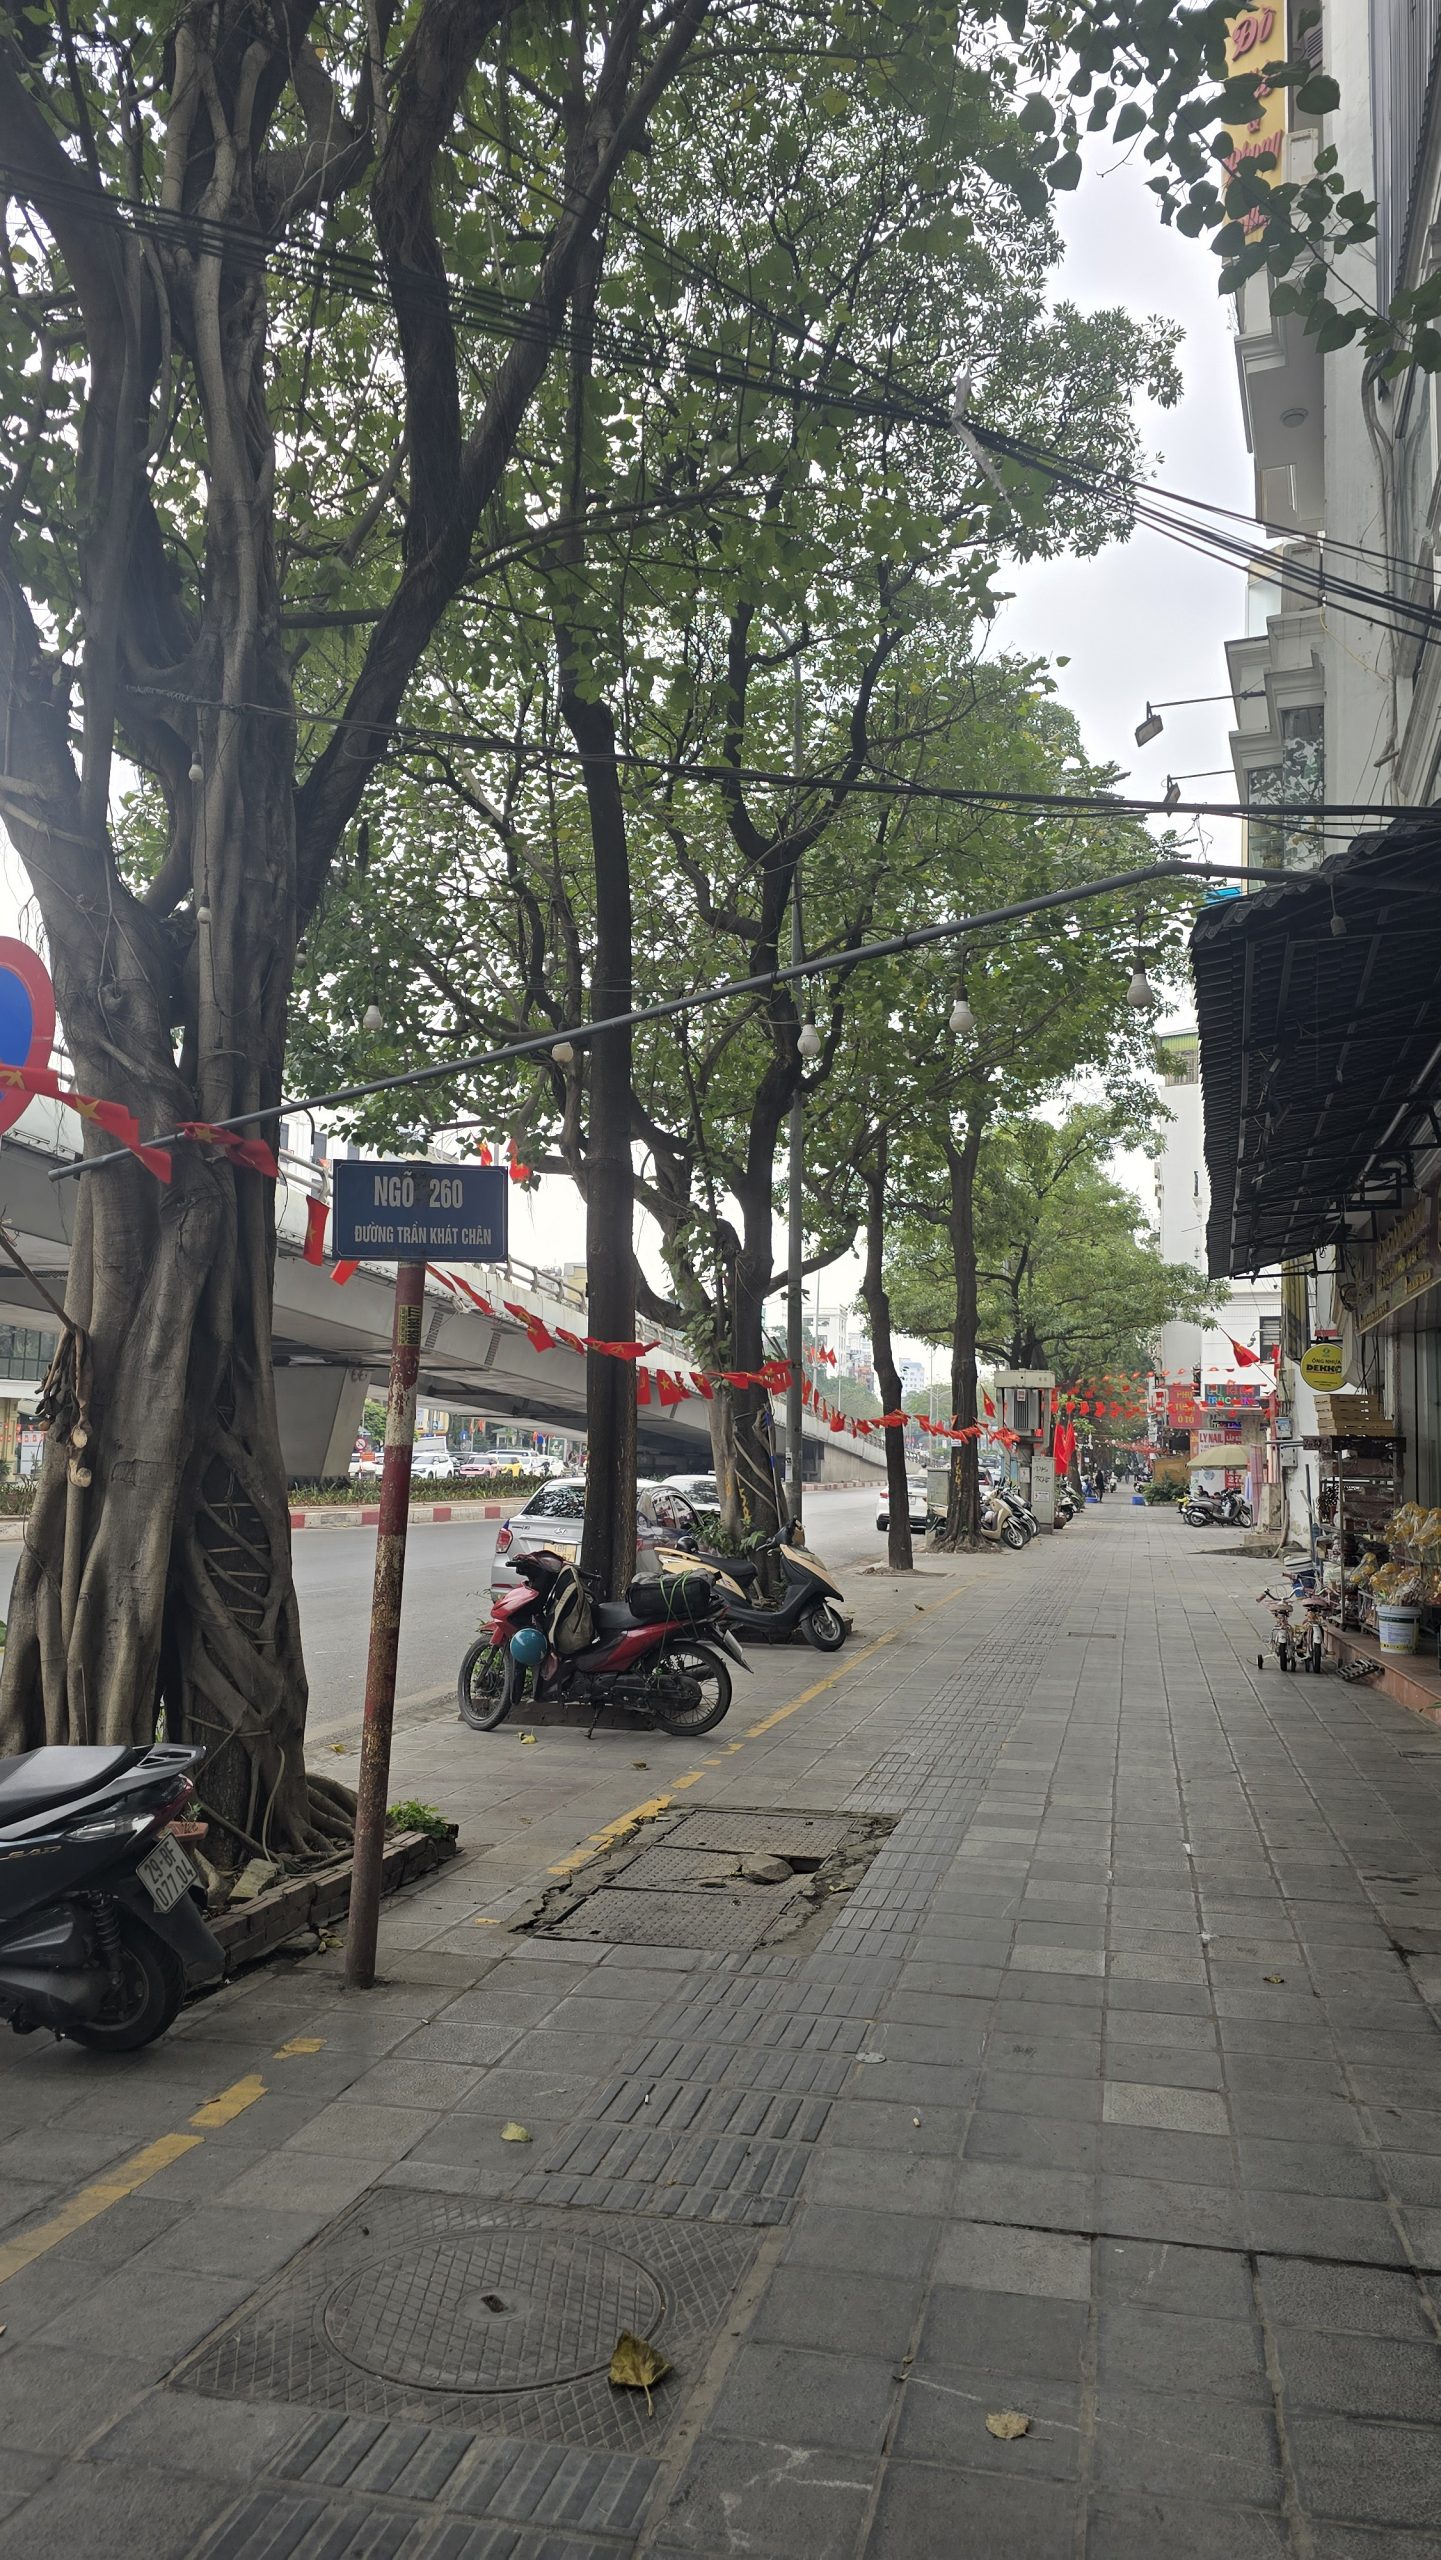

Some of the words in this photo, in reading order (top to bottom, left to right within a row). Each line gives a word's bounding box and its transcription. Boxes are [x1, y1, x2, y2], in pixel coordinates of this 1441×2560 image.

[374, 1171, 414, 1207] NGÕ
[429, 1179, 463, 1208] 260
[354, 1221, 394, 1243] ĐƯỜNG
[397, 1221, 428, 1244] TRẦN
[430, 1223, 459, 1245] KHÁT
[461, 1225, 492, 1245] CHÂN
[144, 1841, 177, 1883] 29-BF
[155, 1859, 194, 1907] 077.04
